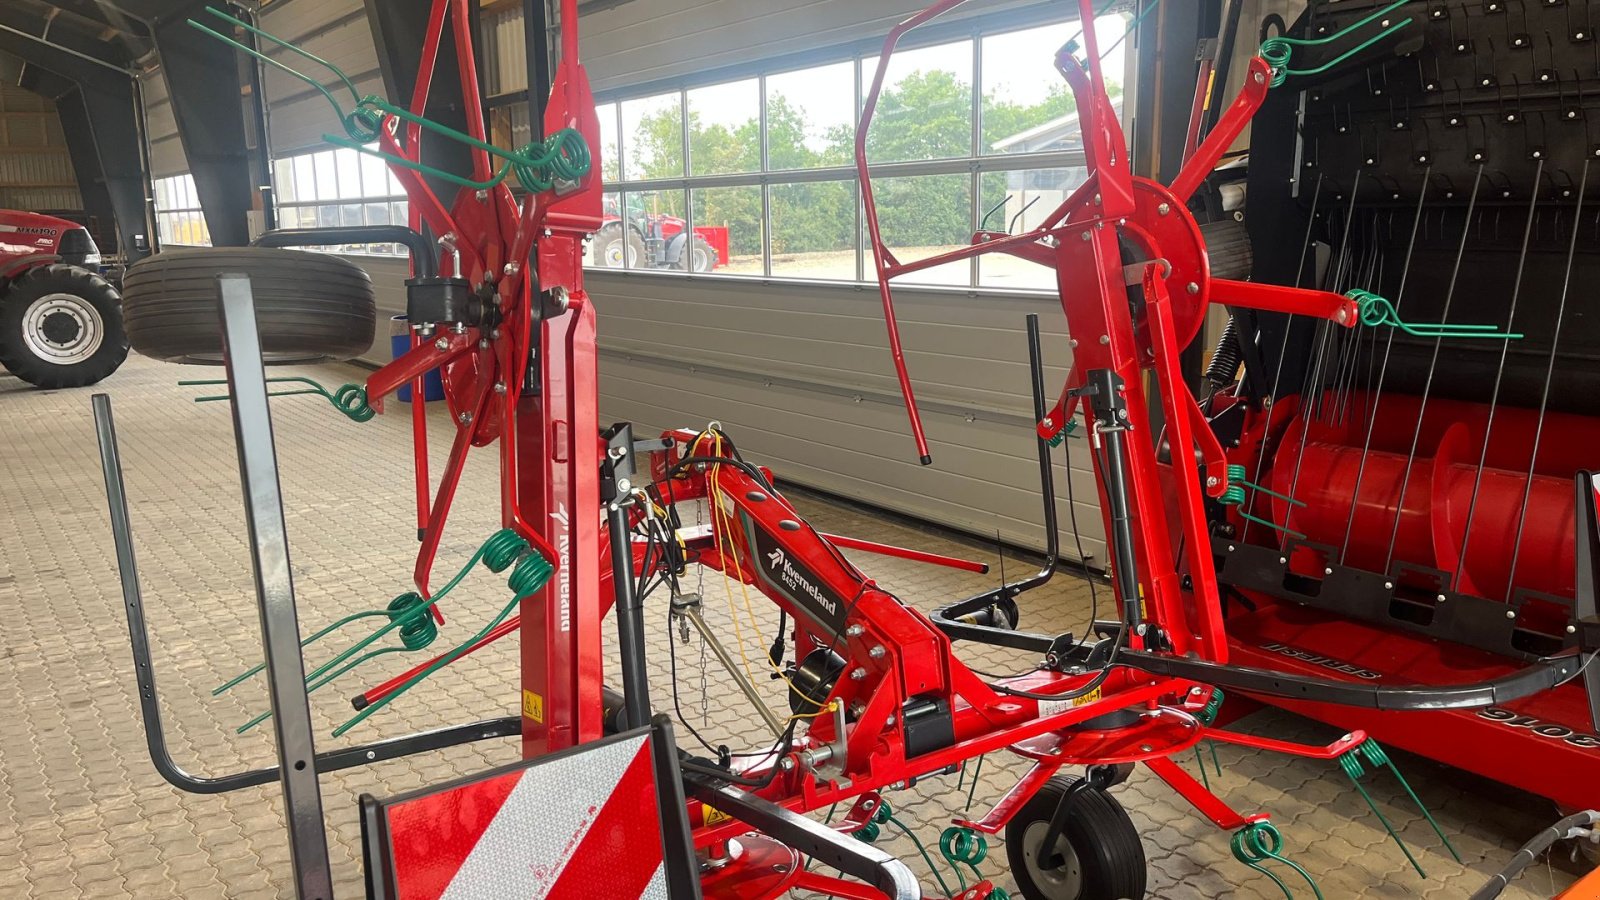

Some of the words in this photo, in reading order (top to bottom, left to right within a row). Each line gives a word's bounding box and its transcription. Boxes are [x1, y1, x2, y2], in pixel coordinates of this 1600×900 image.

[16, 226, 57, 236] MXM190
[781, 571, 798, 592] 8452
[783, 559, 837, 616] Kverneland
